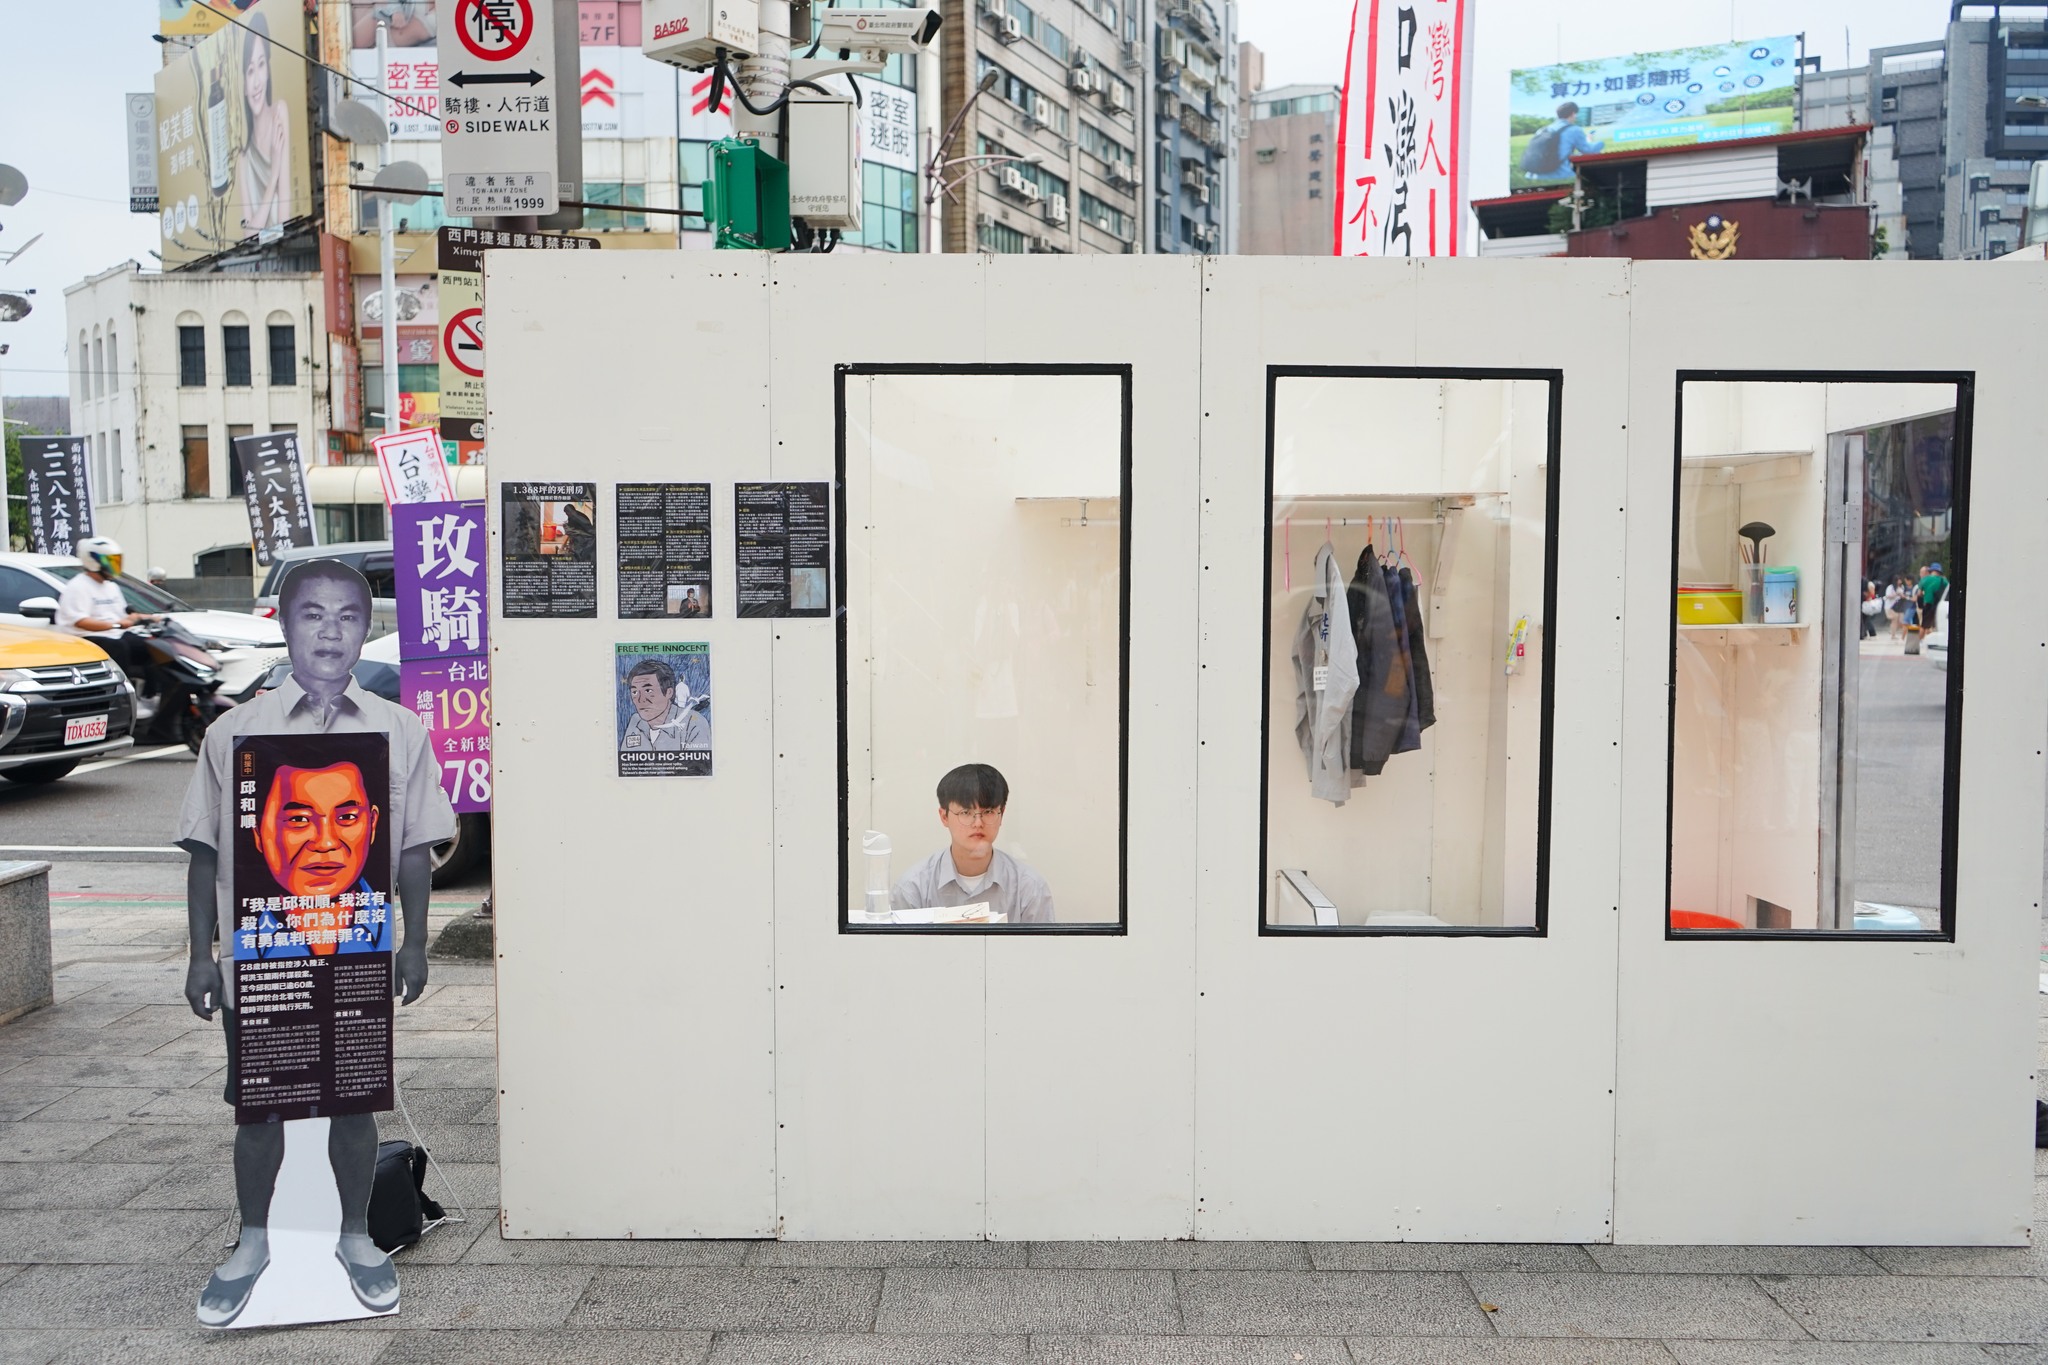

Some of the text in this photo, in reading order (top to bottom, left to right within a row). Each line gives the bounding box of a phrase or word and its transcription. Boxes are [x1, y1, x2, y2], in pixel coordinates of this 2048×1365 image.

[472, 0, 516, 44] 停
[654, 17, 689, 37] BA502
[388, 62, 440, 91] 密室
[1420, 0, 1450, 176] 灣人
[389, 95, 440, 117] SCAP
[870, 90, 910, 126] 密室
[465, 119, 550, 133] SIDEWALK
[870, 121, 911, 157] 逃脫
[465, 175, 534, 187] 違者拖吊
[456, 196, 544, 209] 市民熱線 1999
[447, 228, 592, 250] 西門捷運廣場禁菸區
[415, 513, 483, 652] 玫騎
[617, 645, 639, 653] FREE
[662, 644, 708, 652] INNOCENT
[620, 752, 711, 761] CHIOU HO-SHUN
[240, 781, 256, 829] 邱和順
